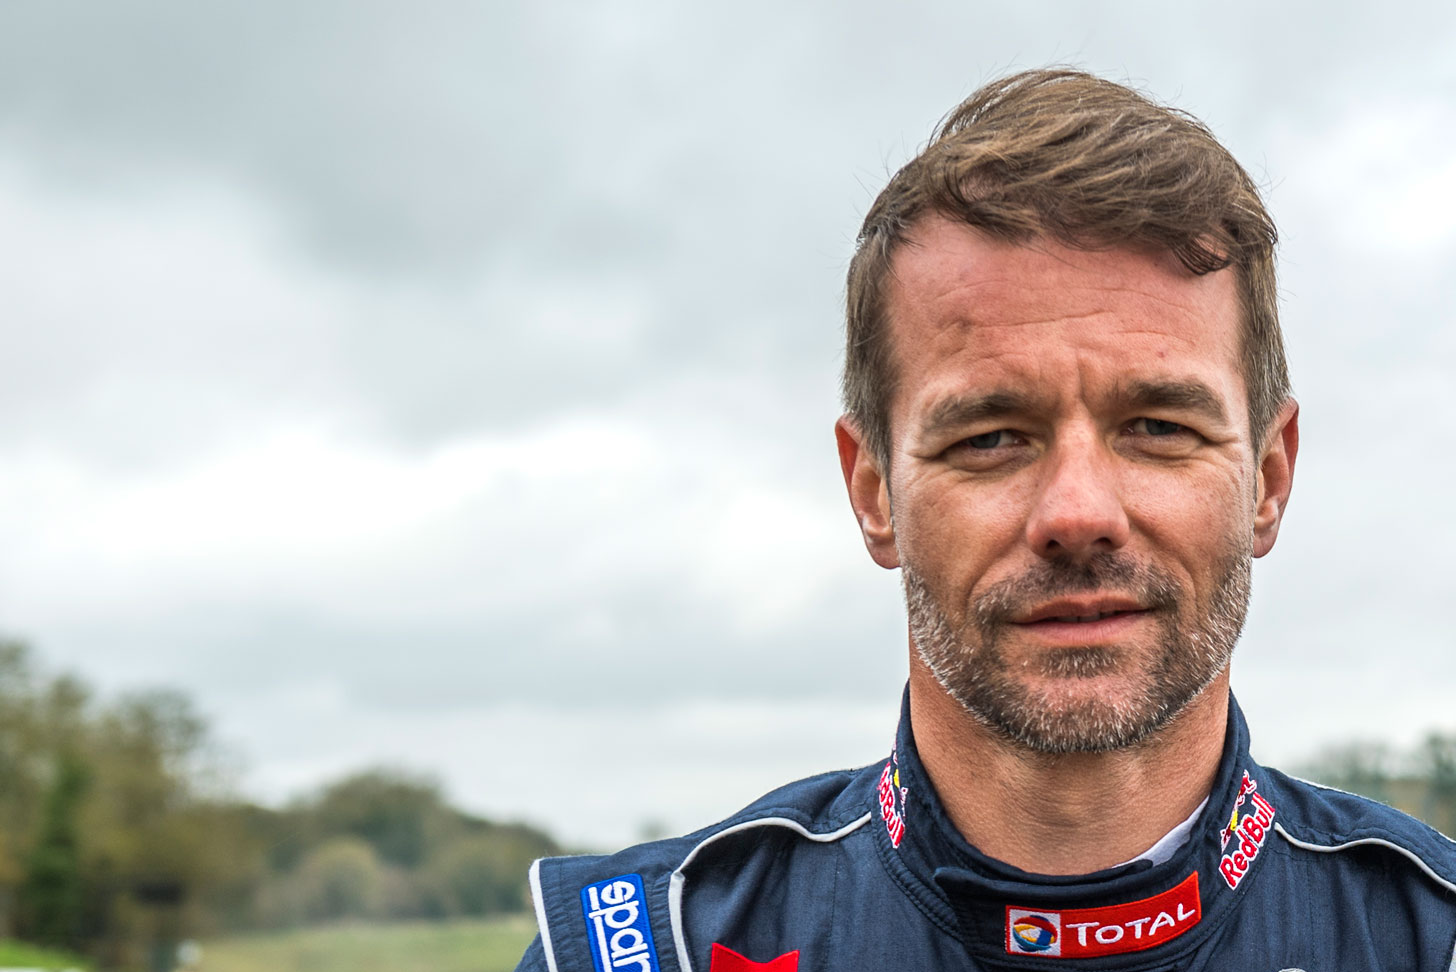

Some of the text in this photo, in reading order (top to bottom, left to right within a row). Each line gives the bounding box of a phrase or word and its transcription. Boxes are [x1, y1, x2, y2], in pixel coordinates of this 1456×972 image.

[1219, 791, 1276, 891] Red Bull
[1066, 903, 1196, 946] TOTAL
